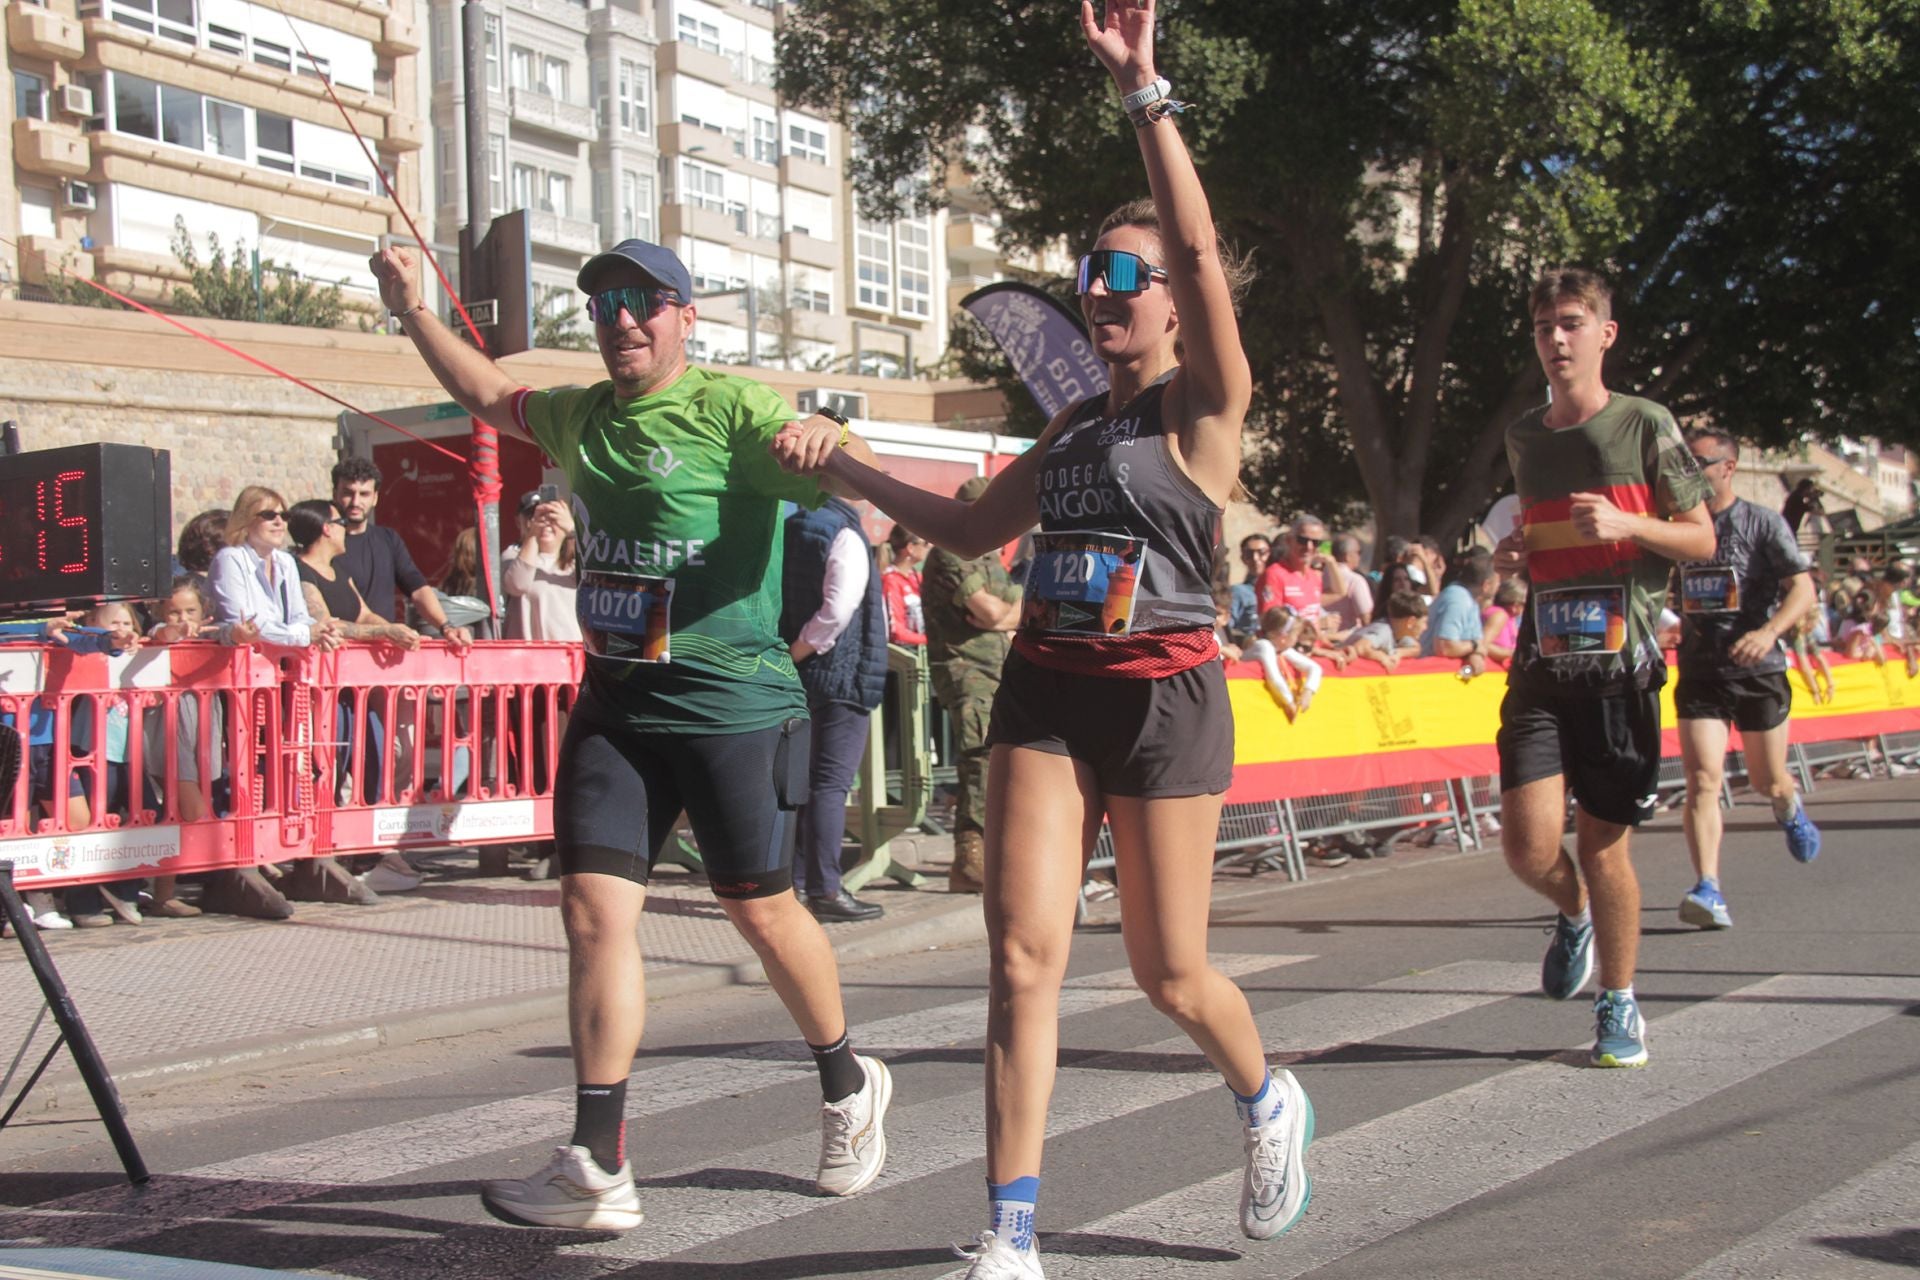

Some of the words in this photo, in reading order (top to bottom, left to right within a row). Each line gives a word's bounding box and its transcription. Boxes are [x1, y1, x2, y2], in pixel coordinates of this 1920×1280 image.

[453, 306, 491, 325] SIDA
[1035, 462, 1130, 494] BODEGAS
[1053, 553, 1095, 583] 120
[1686, 577, 1722, 592] 1187
[588, 590, 642, 619] 1070
[1548, 600, 1602, 624] 1142
[378, 818, 432, 832] Cartagena
[82, 842, 177, 862] Infraestructuras
